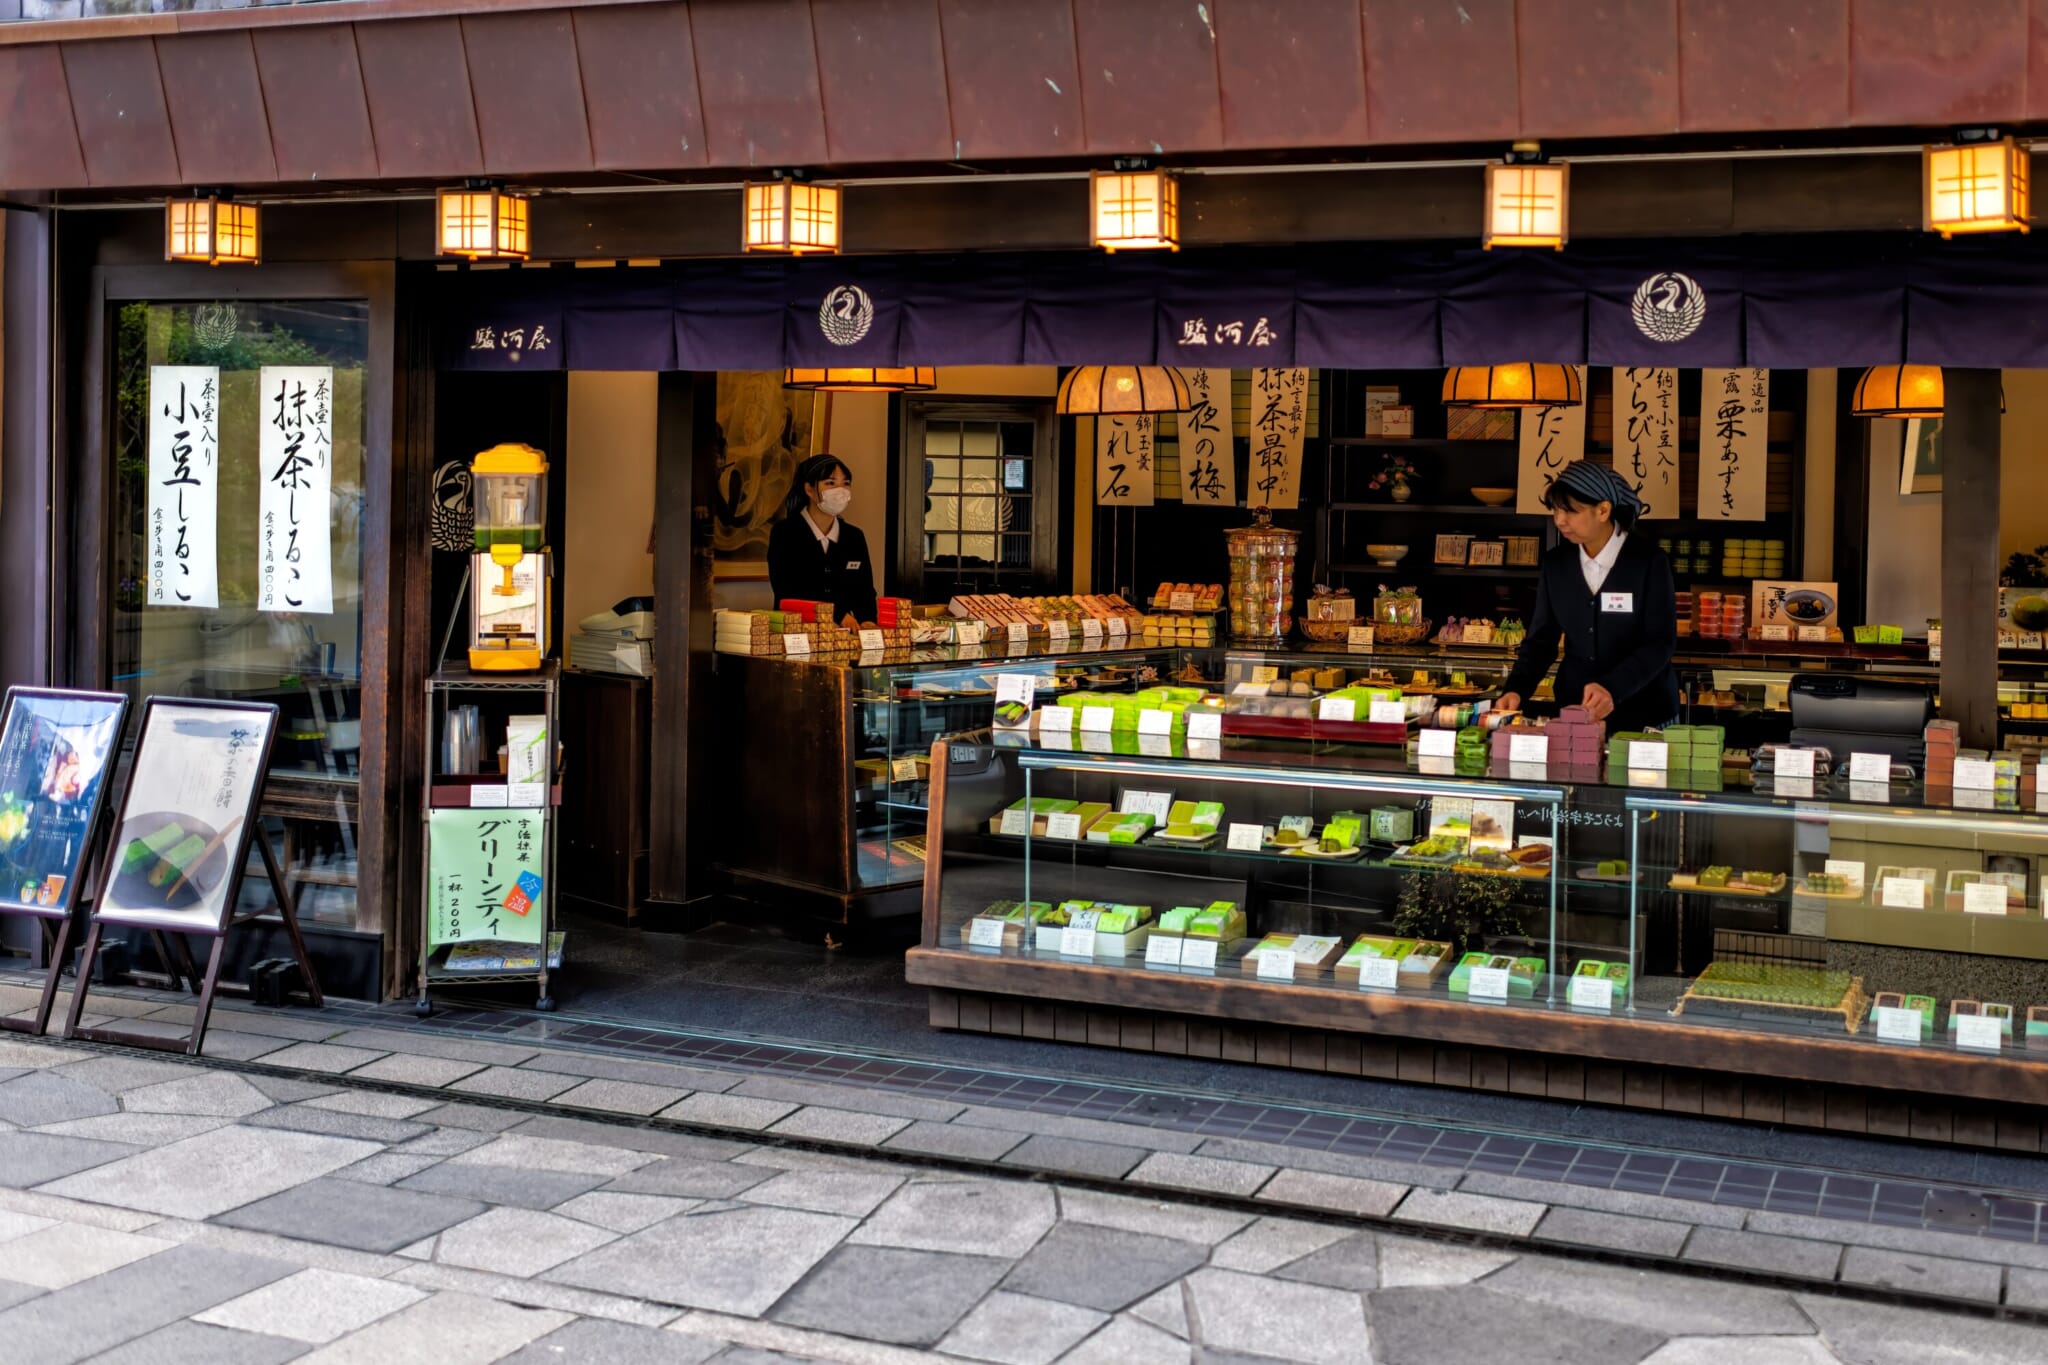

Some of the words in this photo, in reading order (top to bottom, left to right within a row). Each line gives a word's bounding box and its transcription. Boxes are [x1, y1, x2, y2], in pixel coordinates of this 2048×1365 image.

[162, 381, 203, 602] 小豆しるこ
[271, 379, 315, 607] 抹茶しるこ
[475, 818, 512, 937] グリーンティ
[516, 818, 533, 863] 宇治抹茶
